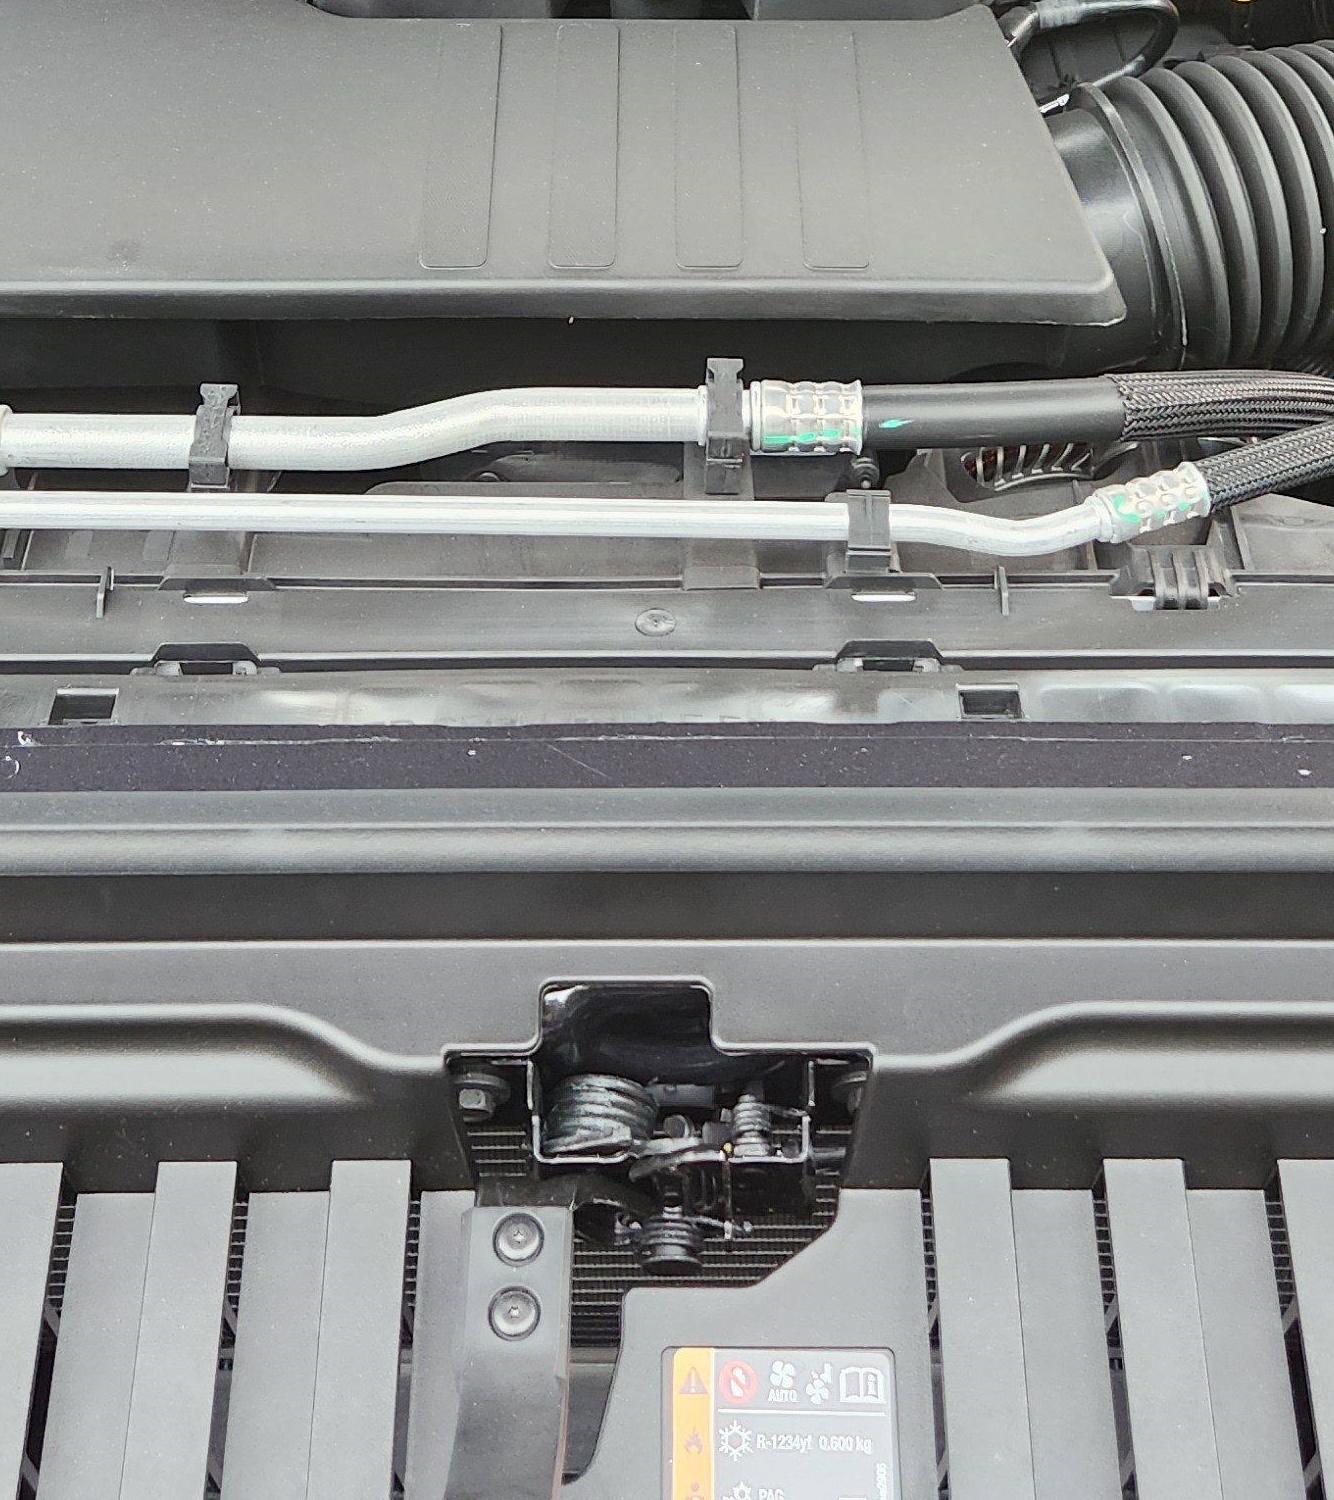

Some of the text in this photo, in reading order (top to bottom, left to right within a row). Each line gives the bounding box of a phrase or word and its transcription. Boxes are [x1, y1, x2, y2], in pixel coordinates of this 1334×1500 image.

[768, 1390, 797, 1402] AUTO
[818, 1435, 854, 1452] 0.600
[856, 1436, 872, 1455] kg
